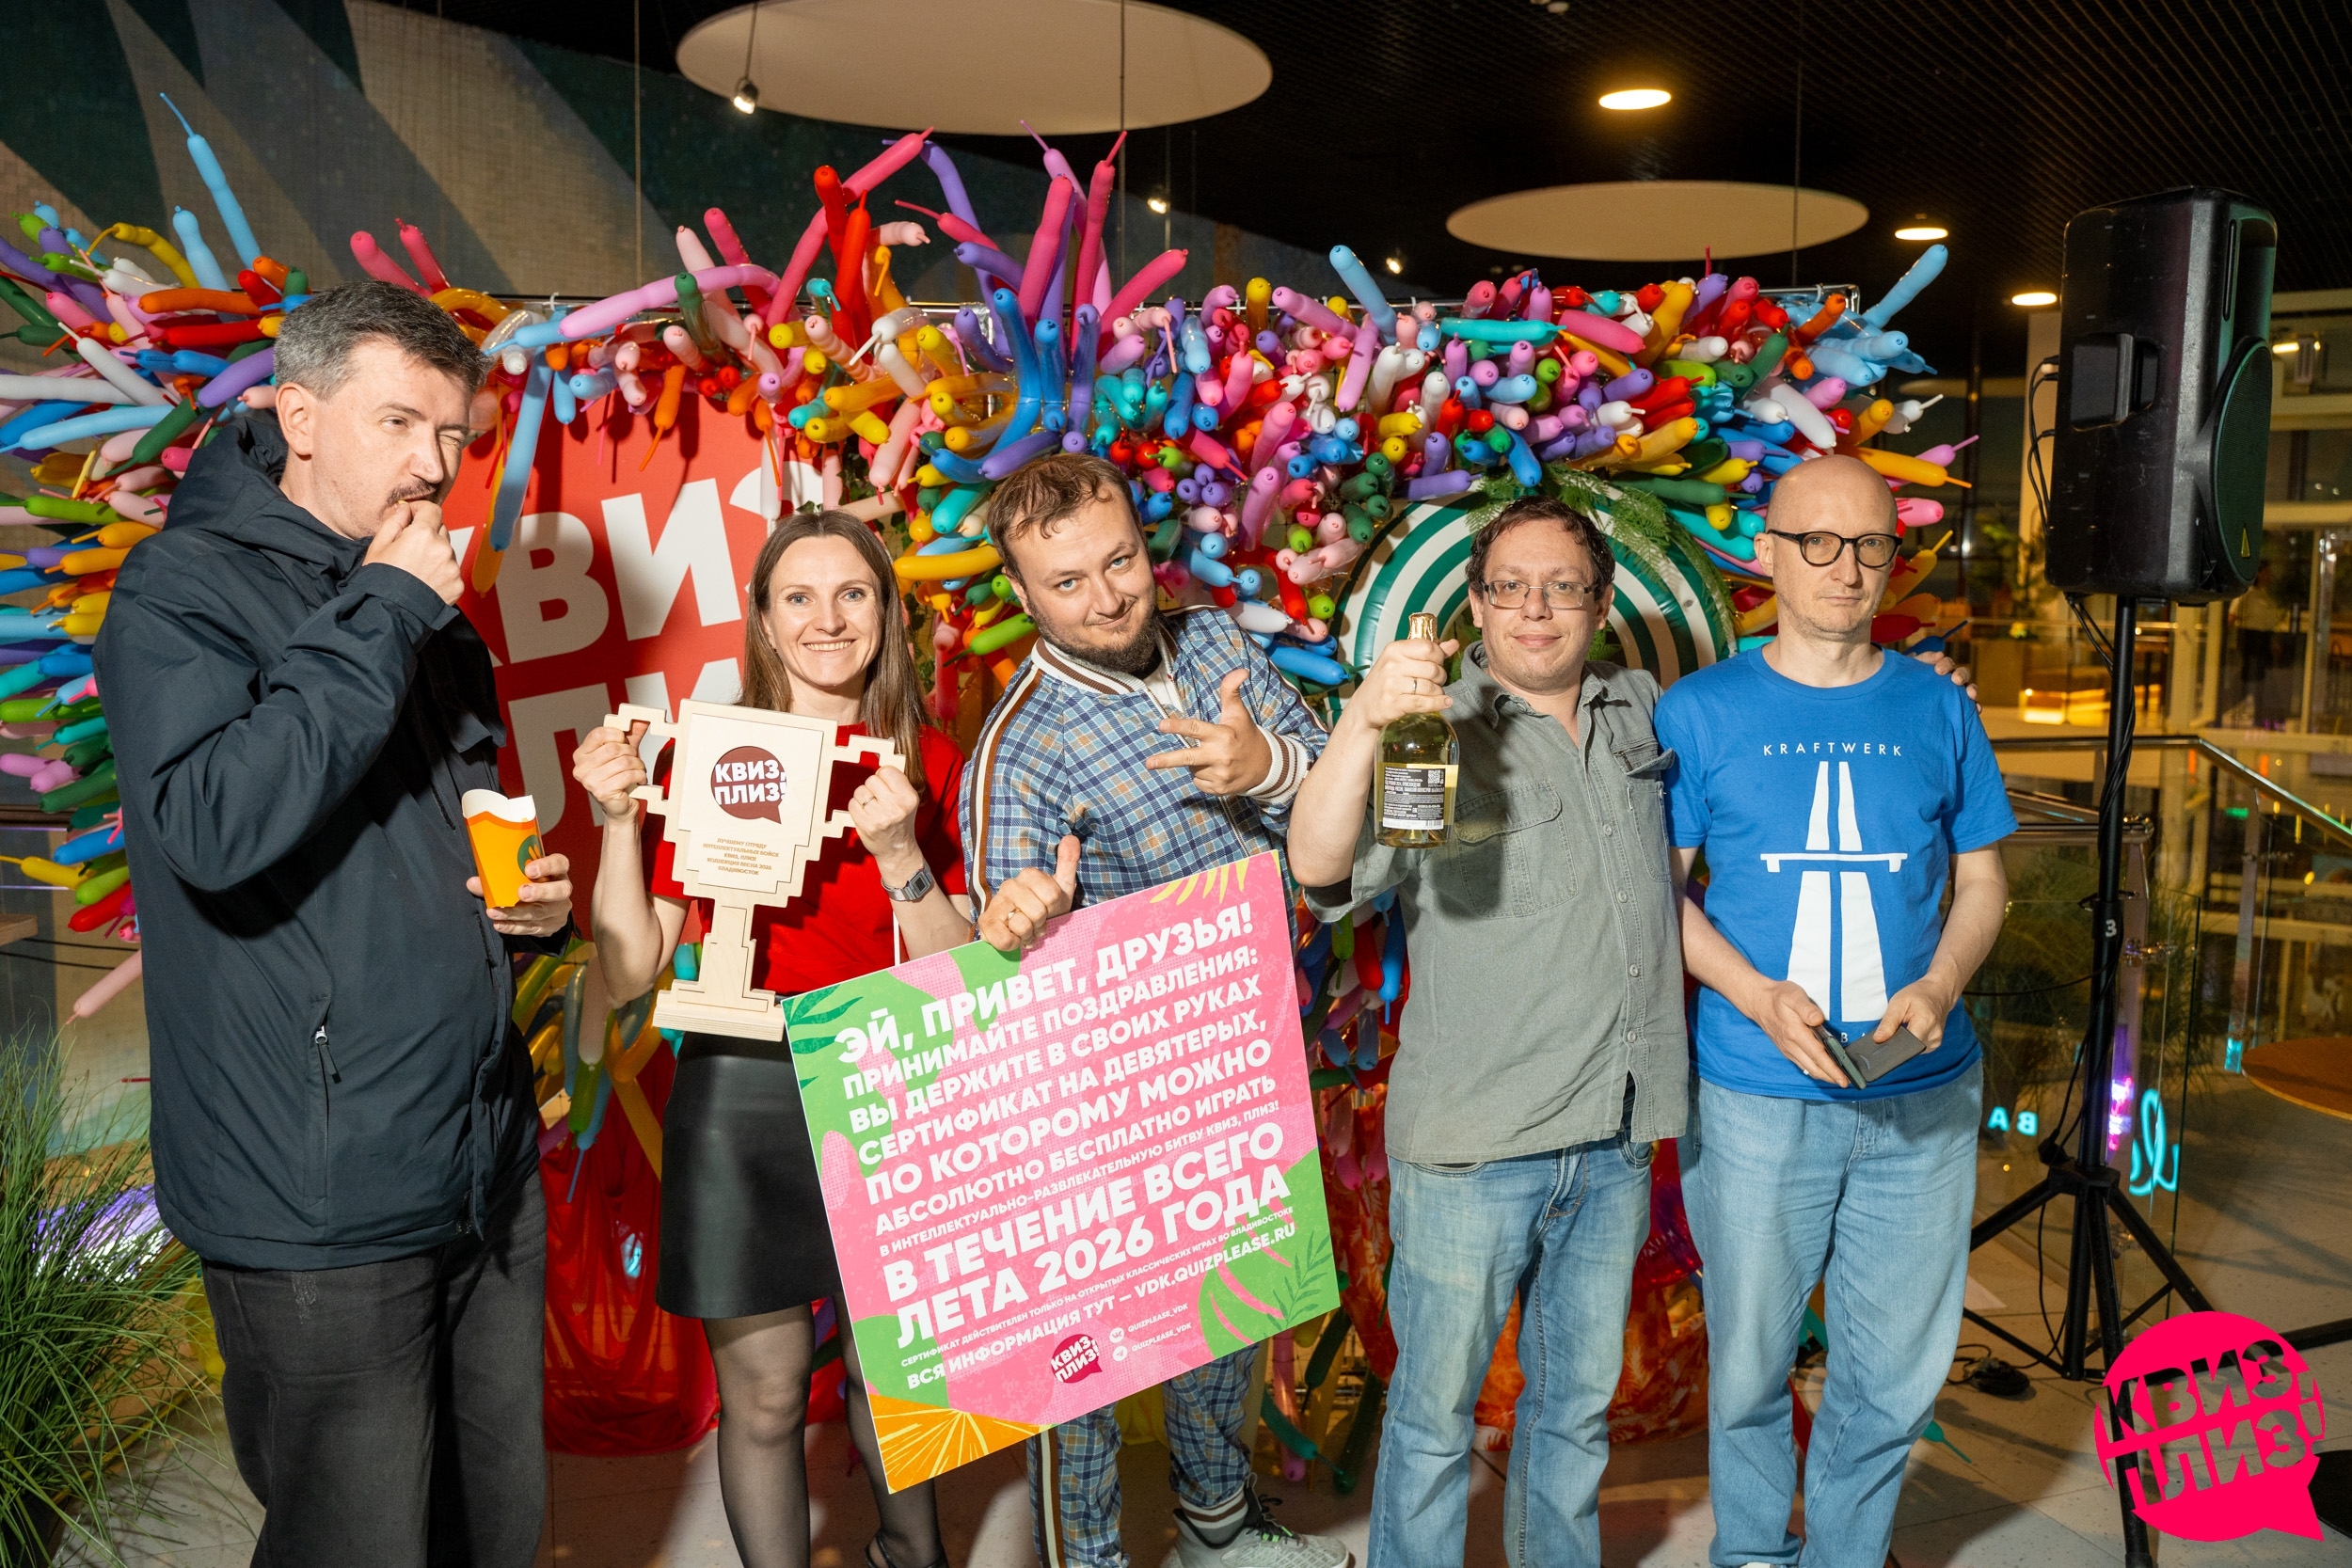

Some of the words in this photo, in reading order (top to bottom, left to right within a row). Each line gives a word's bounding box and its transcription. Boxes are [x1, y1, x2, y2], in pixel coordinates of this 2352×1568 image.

[449, 461, 824, 667] ВИ
[714, 782, 787, 805] ПЛИЗ!
[715, 759, 787, 783] КВИЗ,
[1763, 742, 1901, 756] KRAFTWERK
[834, 1007, 914, 1064] ЭЙ,
[921, 957, 1087, 1037] ПРИВЕТ,
[1095, 901, 1253, 988] ДРУЗЬЯ!
[2105, 918, 2117, 938] 3
[842, 1015, 1040, 1100] ПРИНИМАЙТЕ
[1041, 945, 1258, 1034] ПОЗДРАВЛЕНИЯ:
[849, 1097, 898, 1133] ВЫ
[905, 1048, 1043, 1120] ДЕРЖИТЕ
[1046, 1041, 1067, 1068] В
[1071, 1006, 1170, 1057] СВОИХ
[1173, 974, 1263, 1024] РУКАХ
[858, 1079, 1053, 1165] СЕРТИФИКАТ
[1057, 1066, 1100, 1099] НА
[1103, 1008, 1266, 1087] ДЕВЯТЕРЫХ,
[865, 1163, 923, 1205] ПО
[929, 1085, 1130, 1183] КОТОРОМУ
[1137, 1038, 1271, 1109] МОЖНО
[876, 1159, 1045, 1236] АБСОЛЮТНО
[1048, 1105, 1191, 1173] БЕСПЛАТНО
[1195, 1075, 1276, 1119] ИГРАТЬ
[879, 1244, 890, 1258] В
[891, 1145, 1163, 1253] ИНТЕЛЛЕКТУАЛЬНО-РАЗВЛЕКАТЕЛЬНУЮ
[1164, 1128, 1203, 1152] БИТВУ
[1206, 1116, 1242, 1137] КВИЗ,
[1243, 1100, 1279, 1122] ПЛИЗ!
[882, 1259, 918, 1302] В
[923, 1176, 1136, 1284] ТЕЧЕНИЕ
[1143, 1122, 1283, 1204] ВСЕГО
[897, 1267, 1029, 1349] ЛЕТА
[1034, 1215, 1154, 1294] 2026
[1162, 1164, 1291, 1244] ГОДА
[901, 1338, 960, 1367] СЕРТИФИКАТ
[961, 1312, 1028, 1345] ДЕЙСТВИТЕЛЕН
[1028, 1298, 1064, 1317] ТОЛЬКО
[1064, 1293, 1077, 1304] НА
[1077, 1274, 1125, 1298] ОТКРЫТЫХ
[1126, 1248, 1191, 1279] КЛАССИЧЕСКИХ
[1192, 1237, 1217, 1252] ИГРАХ
[1217, 1232, 1230, 1243] ВО
[1231, 1207, 1293, 1237] ВЛАДИВОСТОКЕ
[907, 1363, 946, 1389] ВСЯ
[947, 1308, 1081, 1373] ИНФОРМАЦИЯ
[1082, 1295, 1115, 1319] ТУТ
[1134, 1222, 1295, 1298] VDK.QUIZPLEASE.RU
[1051, 1336, 1097, 1371] КВИЗ,
[1055, 1345, 1100, 1383] ПЛИЗ!
[1128, 1304, 1188, 1332] QUIZPLEASE_VDK
[1131, 1323, 1191, 1352] QUIZPLEASE_VDK
